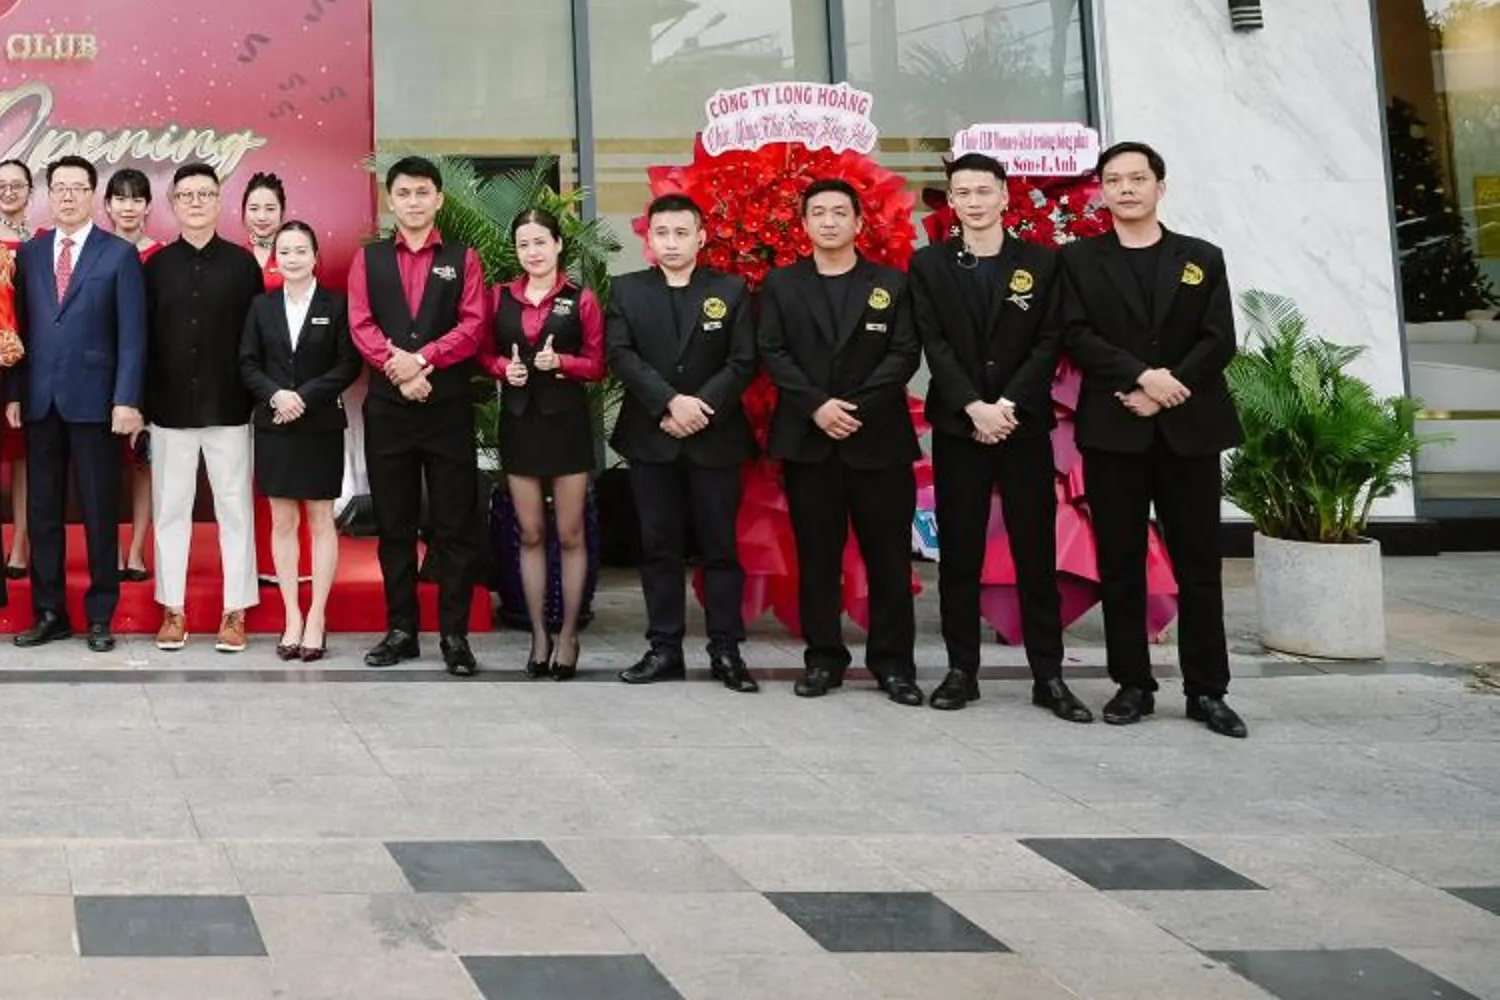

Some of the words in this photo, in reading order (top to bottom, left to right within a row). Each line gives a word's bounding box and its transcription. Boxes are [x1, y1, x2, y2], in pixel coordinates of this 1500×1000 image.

[7, 33, 98, 60] CLUB
[708, 92, 749, 118] CÔNG
[752, 87, 770, 107] TY
[775, 85, 813, 105] LONG
[817, 83, 869, 116] HOÀNG
